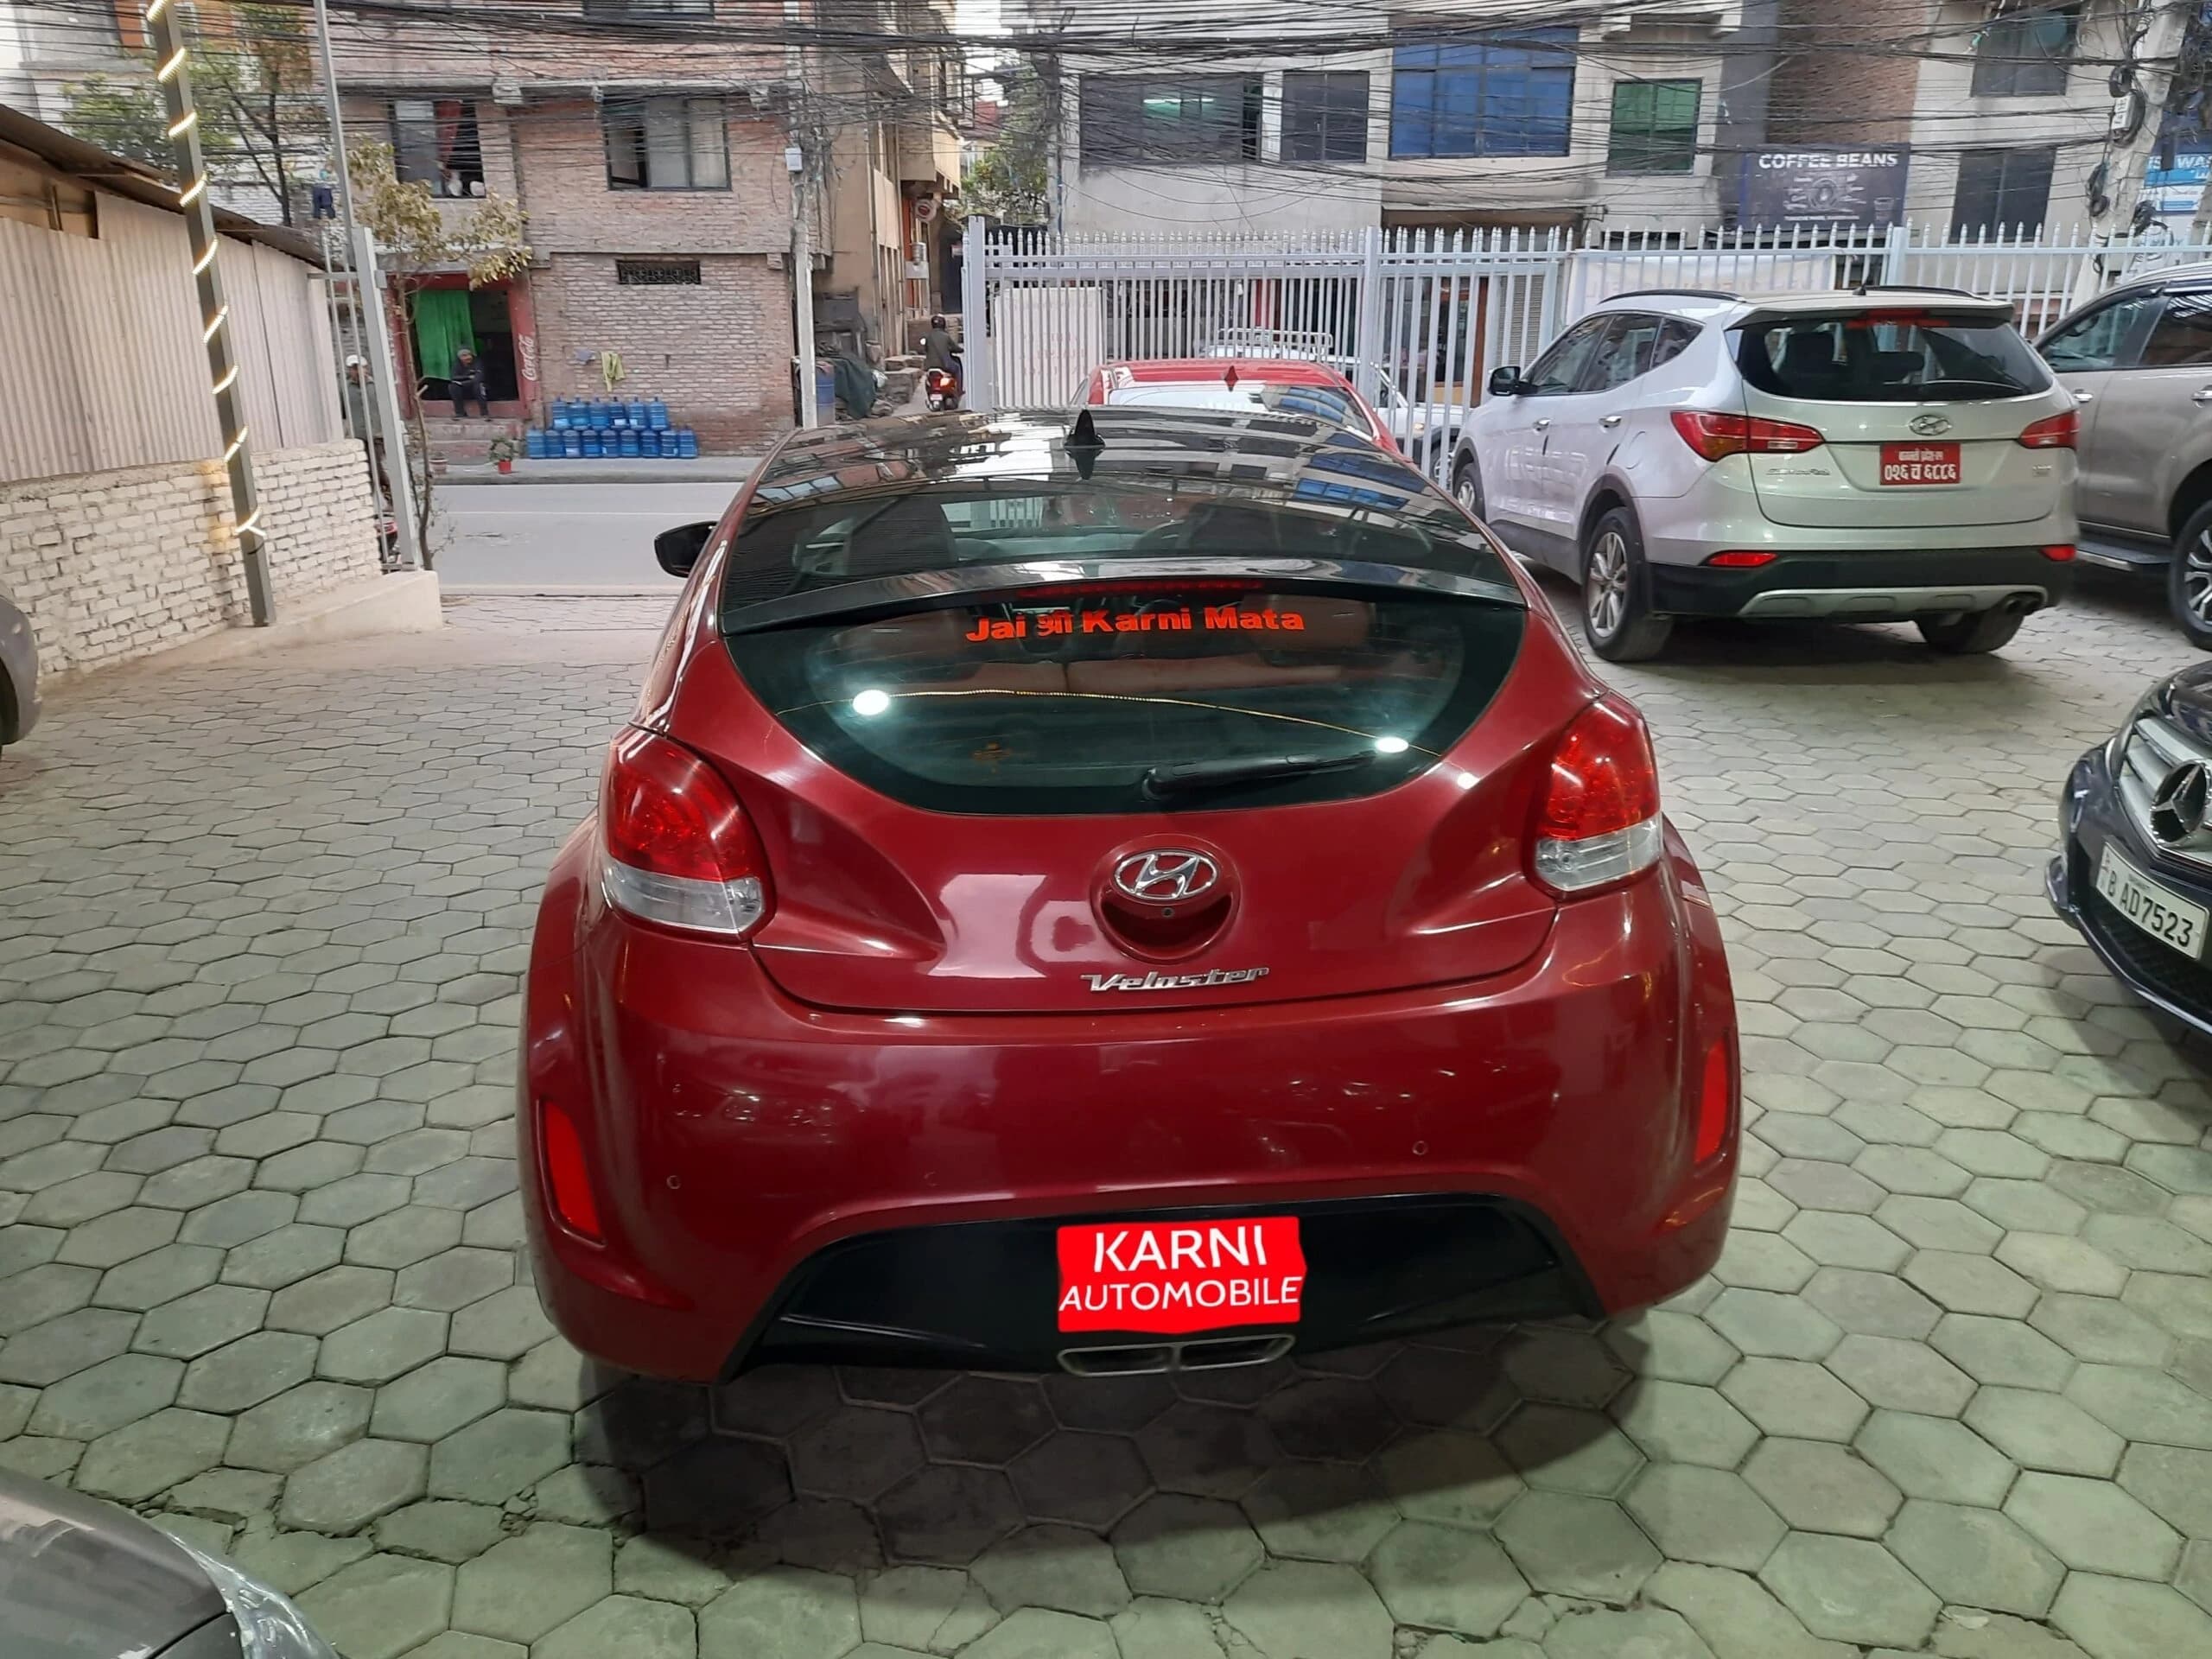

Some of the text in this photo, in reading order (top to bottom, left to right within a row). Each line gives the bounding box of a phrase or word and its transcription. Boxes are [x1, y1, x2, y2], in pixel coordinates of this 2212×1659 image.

[1758, 153, 1898, 169] COFFEE BEANS
[965, 613, 1027, 642] Jai
[1082, 607, 1192, 633] Karni
[1205, 607, 1306, 631] Mata
[2107, 870, 2194, 948] B AD7523
[1080, 967, 1269, 992] Veloster
